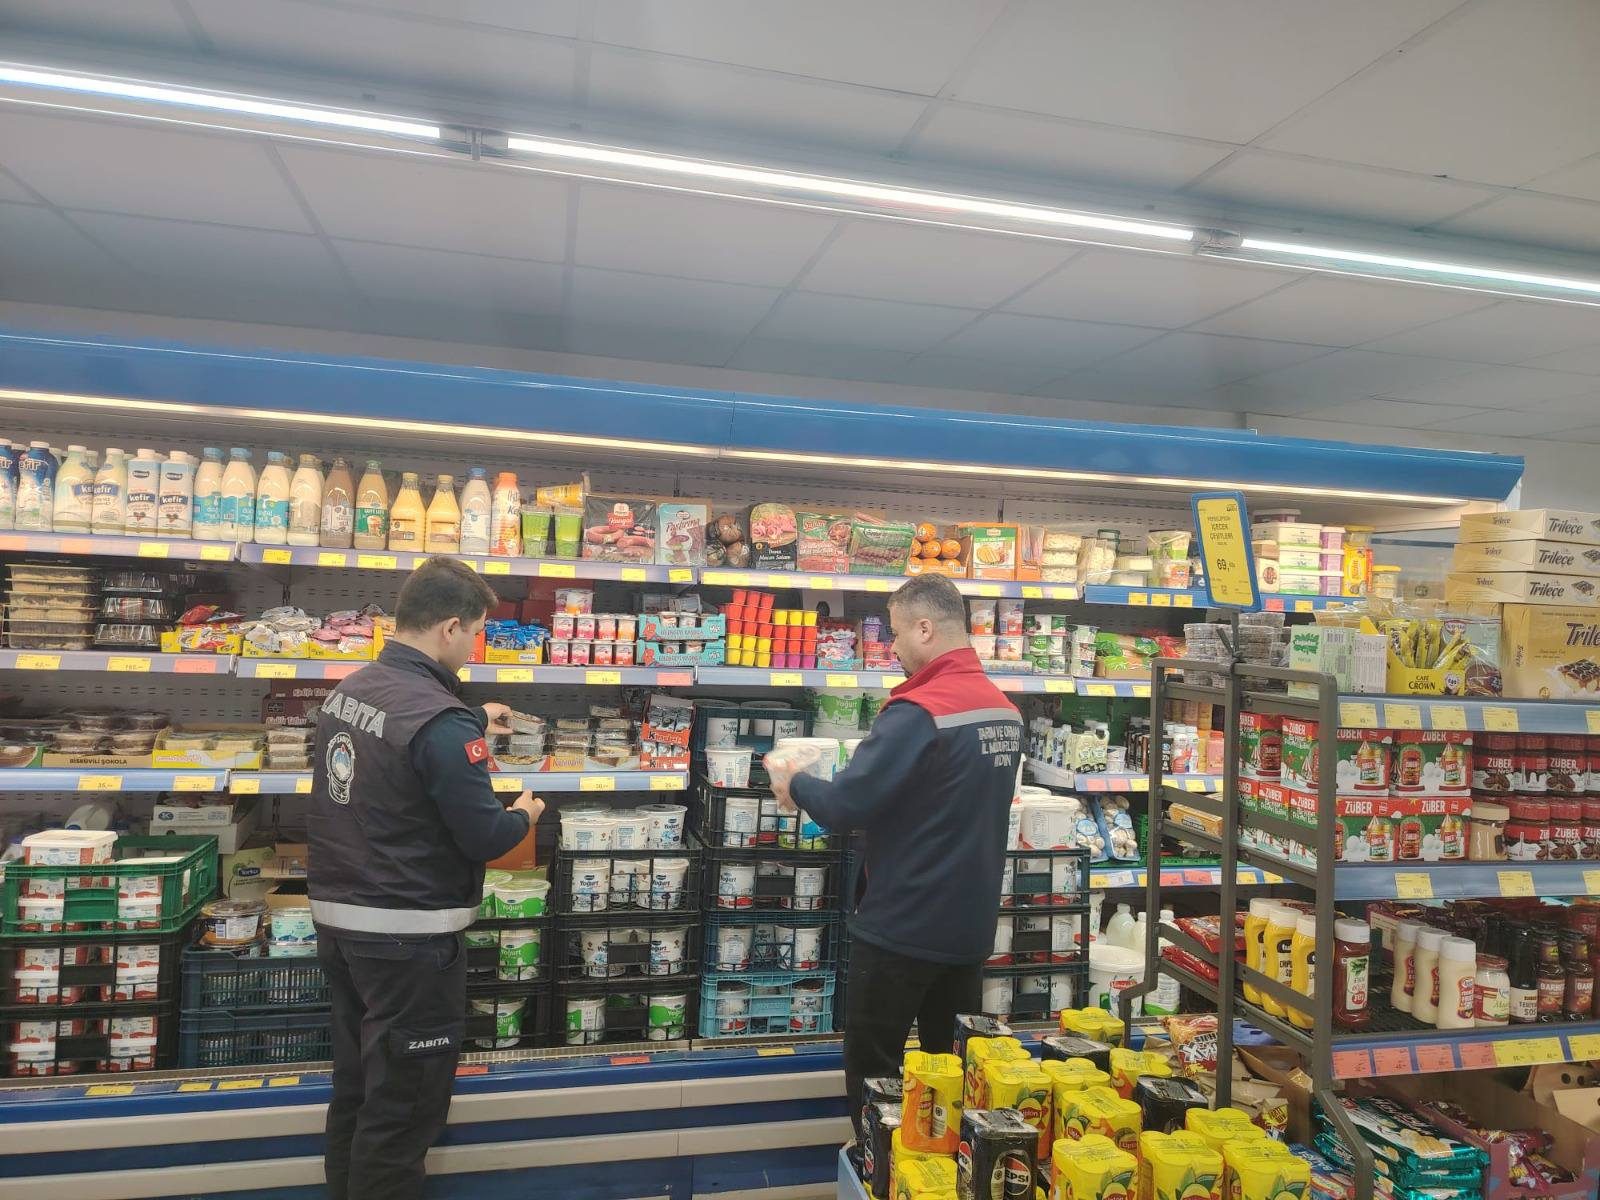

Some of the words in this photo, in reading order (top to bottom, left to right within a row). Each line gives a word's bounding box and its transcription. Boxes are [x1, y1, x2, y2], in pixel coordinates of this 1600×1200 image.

[129, 494, 150, 502] kefir
[161, 496, 183, 504] kefir
[1549, 517, 1583, 536] Trileçe
[1539, 549, 1574, 567] Trileçe
[1529, 581, 1564, 599] Trileçe
[1566, 622, 1600, 646] Trile
[1408, 681, 1436, 690] CROWN
[1345, 800, 1373, 814] ZÜBER
[1422, 800, 1446, 812] ZÜBER
[408, 1037, 450, 1049] ZABITA
[1004, 1171, 1029, 1183] EPSI
